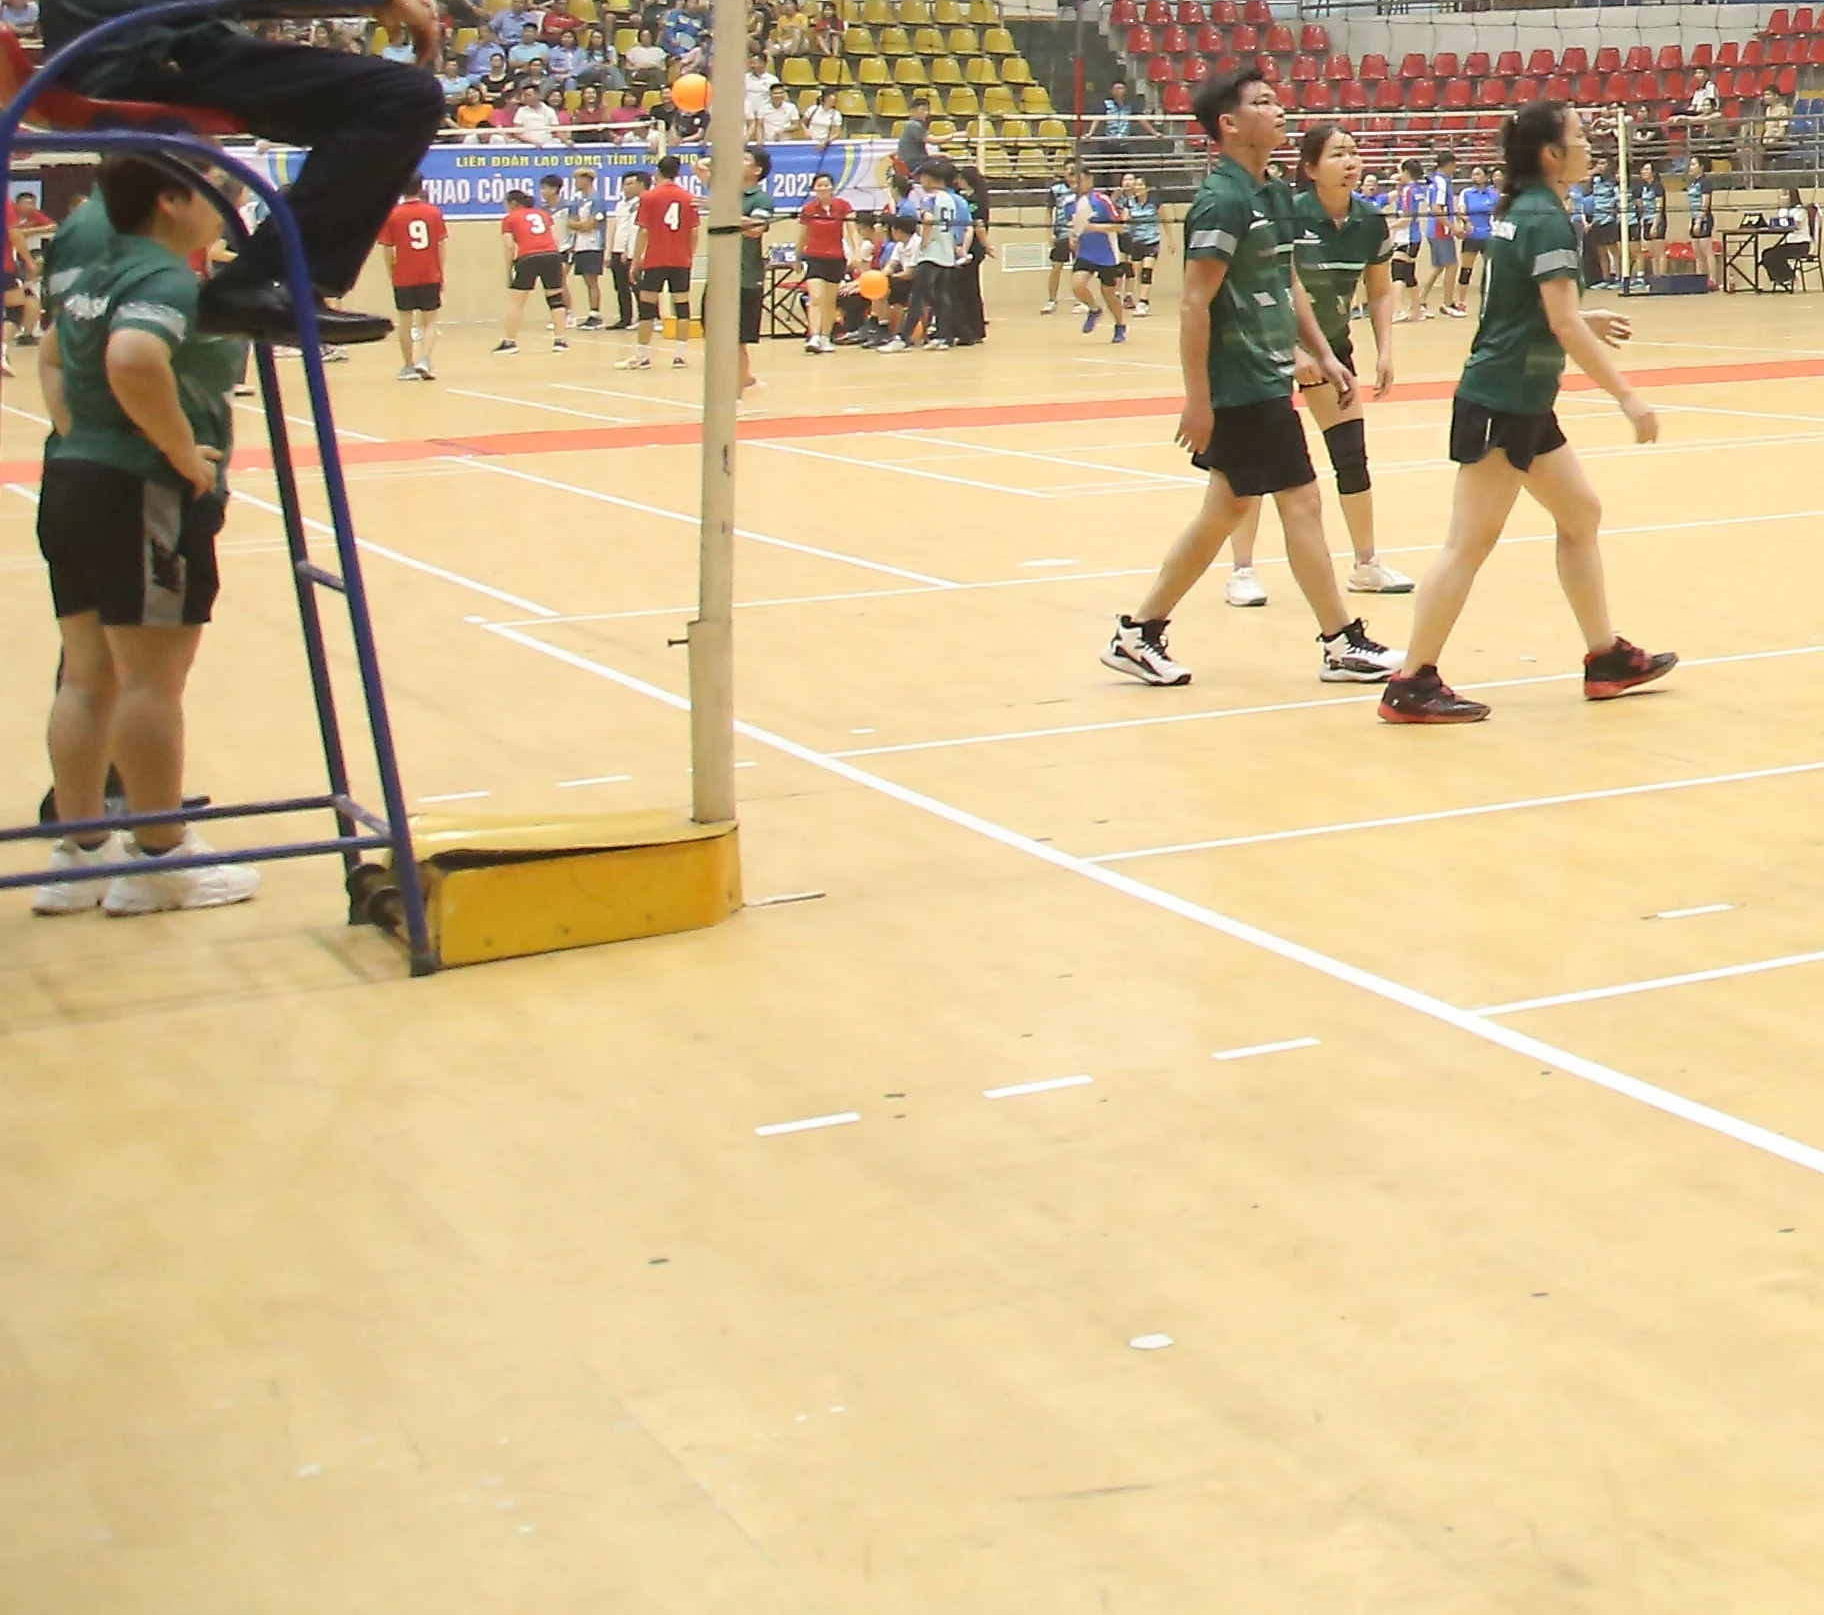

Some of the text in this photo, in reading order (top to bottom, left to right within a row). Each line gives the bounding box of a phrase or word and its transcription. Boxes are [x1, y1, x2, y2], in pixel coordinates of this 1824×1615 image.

[456, 153, 485, 168] LIÊN
[534, 154, 558, 167] LAO
[478, 173, 535, 205] CÔNG
[773, 173, 818, 198] 2025
[525, 213, 546, 234] 3
[663, 202, 681, 232] 4
[408, 219, 429, 251] 9
